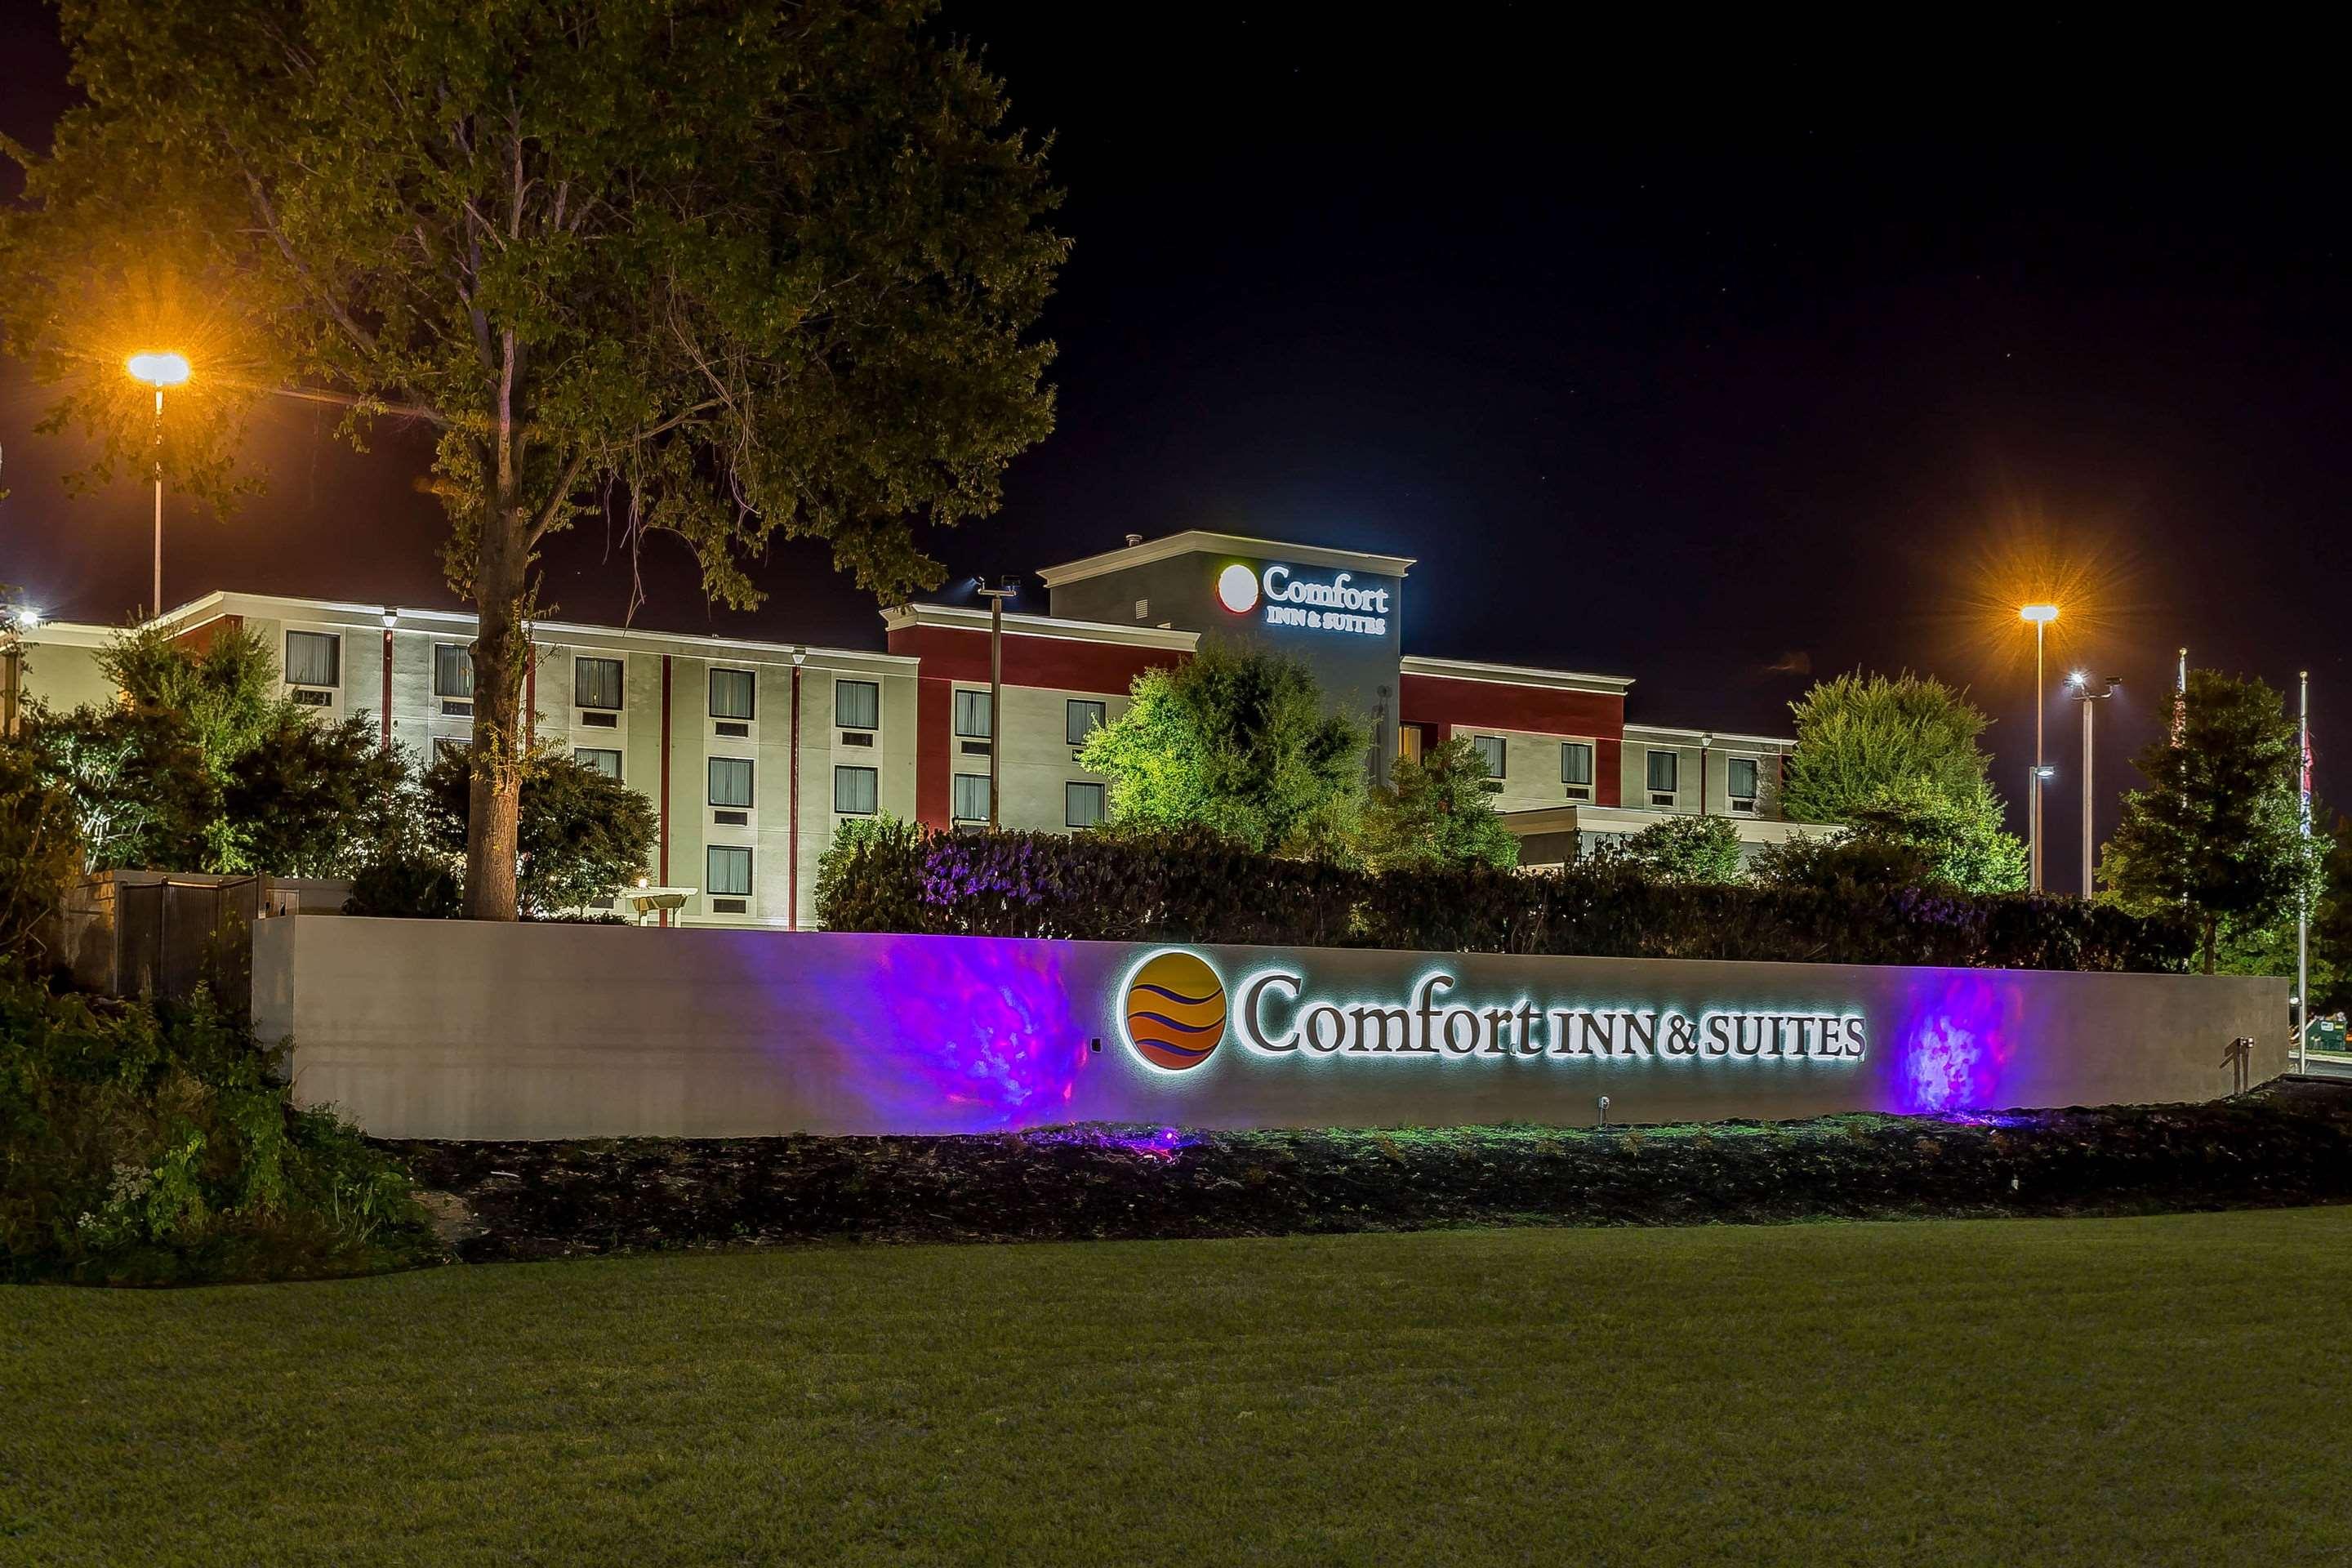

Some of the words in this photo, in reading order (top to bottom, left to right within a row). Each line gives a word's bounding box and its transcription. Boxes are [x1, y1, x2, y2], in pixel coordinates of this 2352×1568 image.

[1263, 567, 1388, 612] Comfort
[1267, 607, 1306, 626] INN
[1308, 612, 1321, 628] &
[1324, 613, 1385, 635] SUITES
[1245, 974, 1544, 1054] Comfort
[1552, 1013, 1656, 1055] INN
[1668, 1015, 1698, 1055] &
[1706, 1015, 1865, 1056] SUITES
